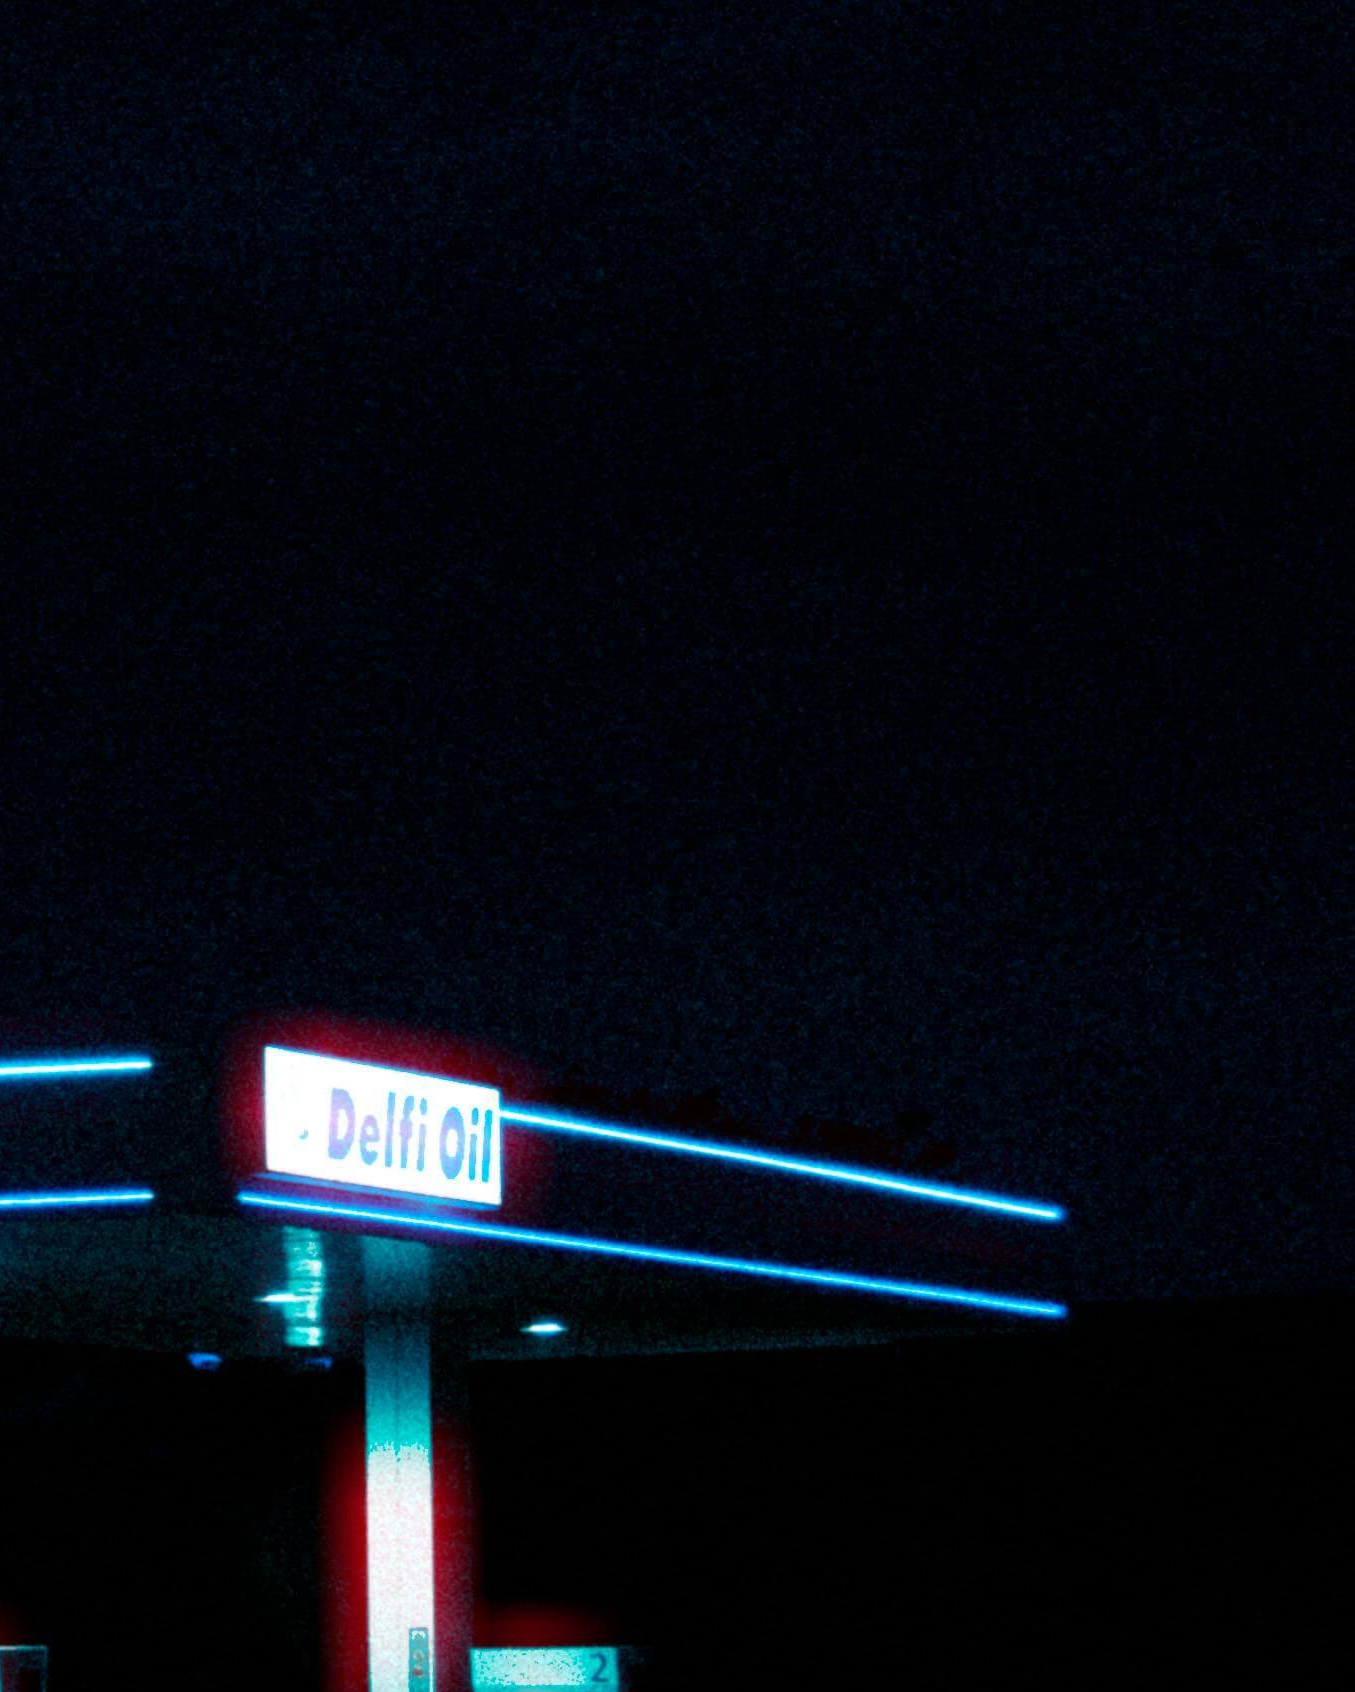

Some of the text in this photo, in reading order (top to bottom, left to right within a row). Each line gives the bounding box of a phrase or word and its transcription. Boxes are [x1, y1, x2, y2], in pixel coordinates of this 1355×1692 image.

[328, 1088, 492, 1182] Delfi Oil
[591, 1653, 610, 1683] 2
